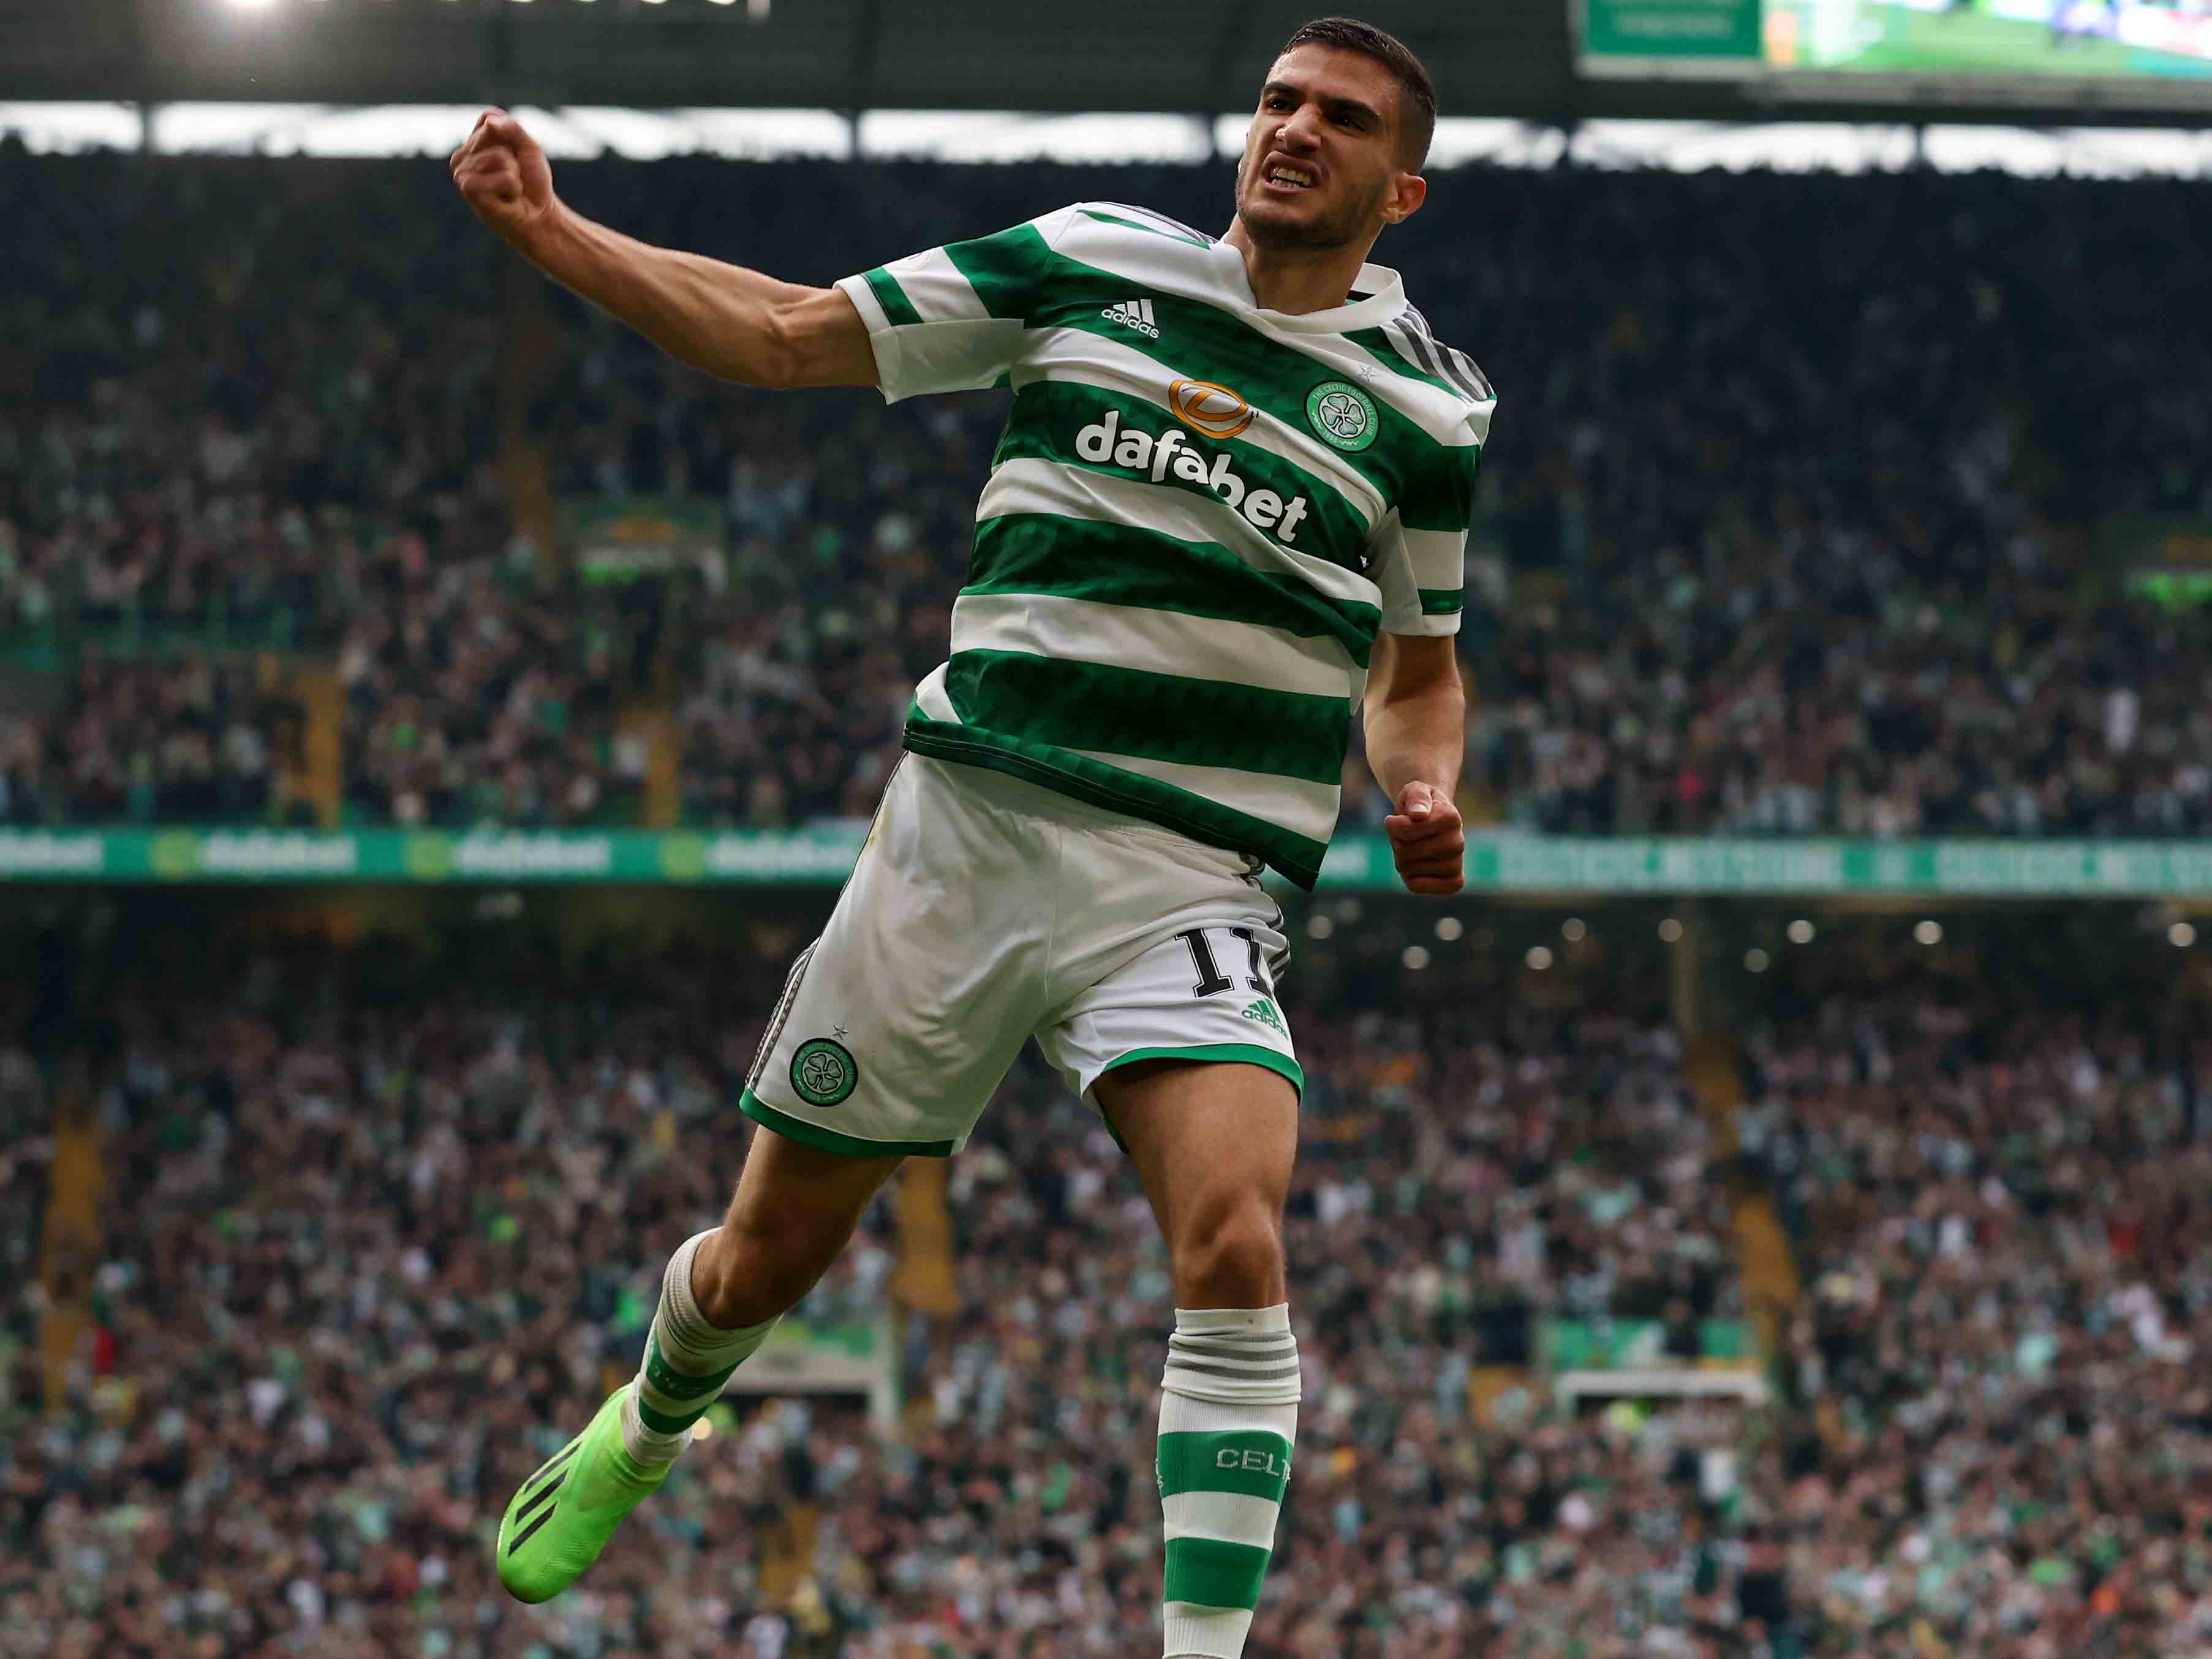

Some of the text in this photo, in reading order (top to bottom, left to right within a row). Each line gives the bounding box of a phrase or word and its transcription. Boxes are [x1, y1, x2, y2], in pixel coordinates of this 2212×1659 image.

[1101, 309, 1160, 338] adidas
[1312, 387, 1324, 400] THE
[1323, 384, 1346, 393] CELTIC
[1076, 410, 1307, 542] dafabet
[1174, 927, 1274, 999] 11
